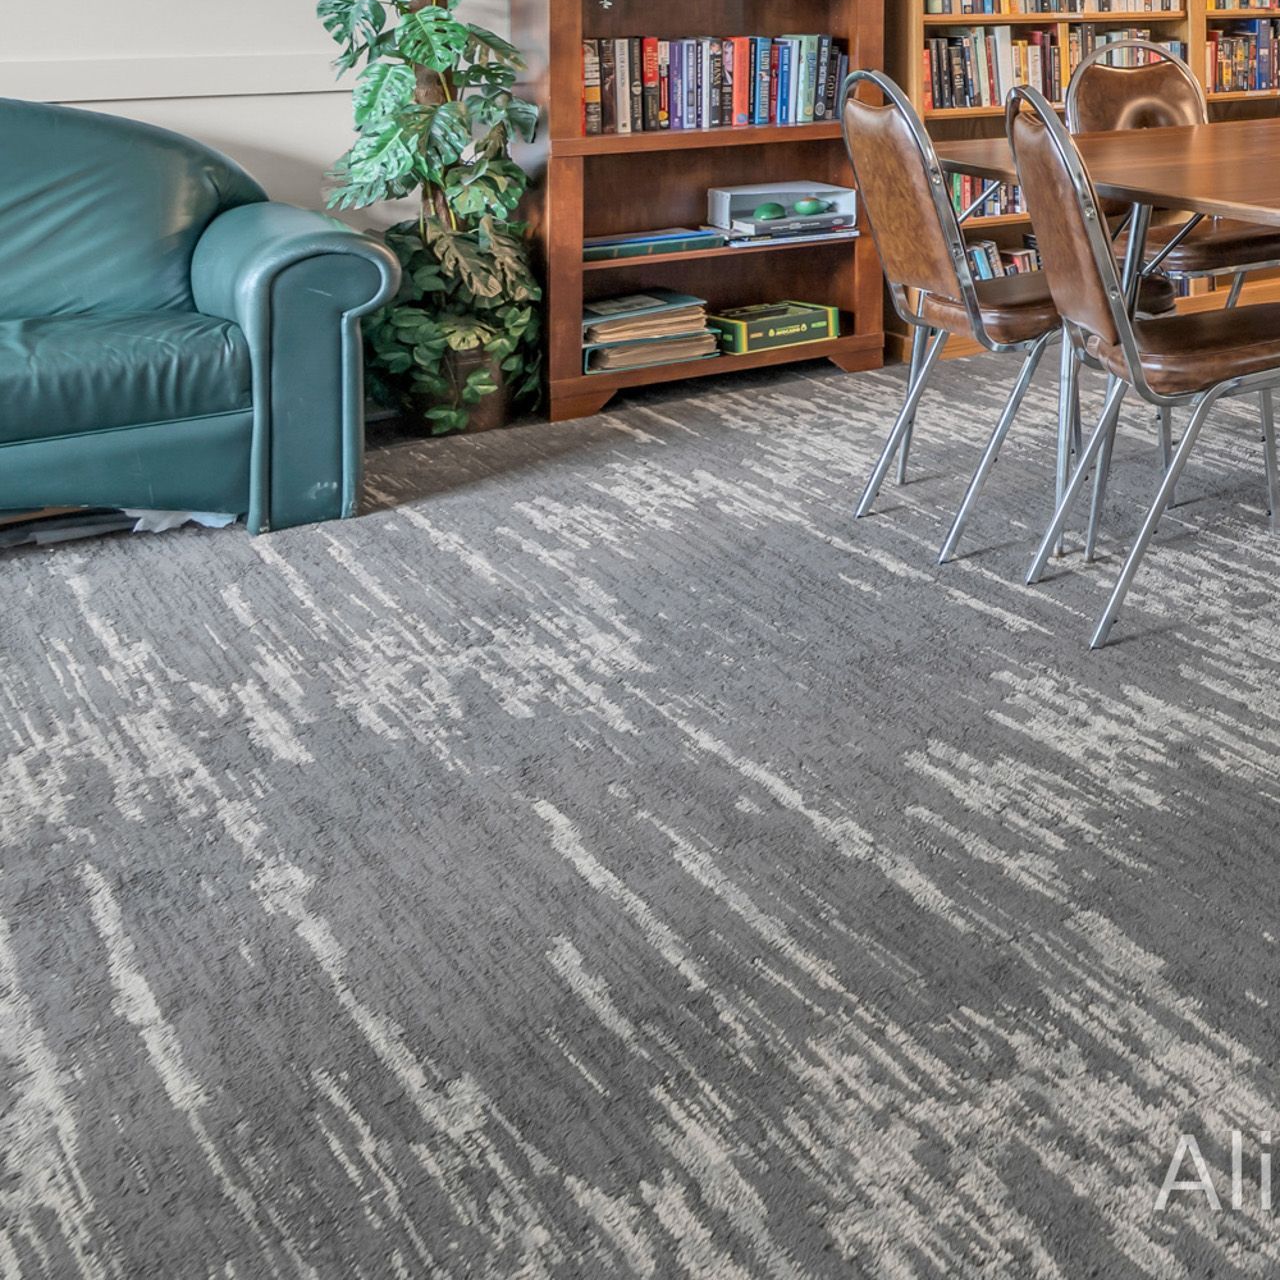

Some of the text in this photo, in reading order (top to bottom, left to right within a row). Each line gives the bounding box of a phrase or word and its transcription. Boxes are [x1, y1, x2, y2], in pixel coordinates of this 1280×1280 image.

[760, 50, 770, 118] LLOYD ROBERTSON
[827, 75, 836, 97] GOD
